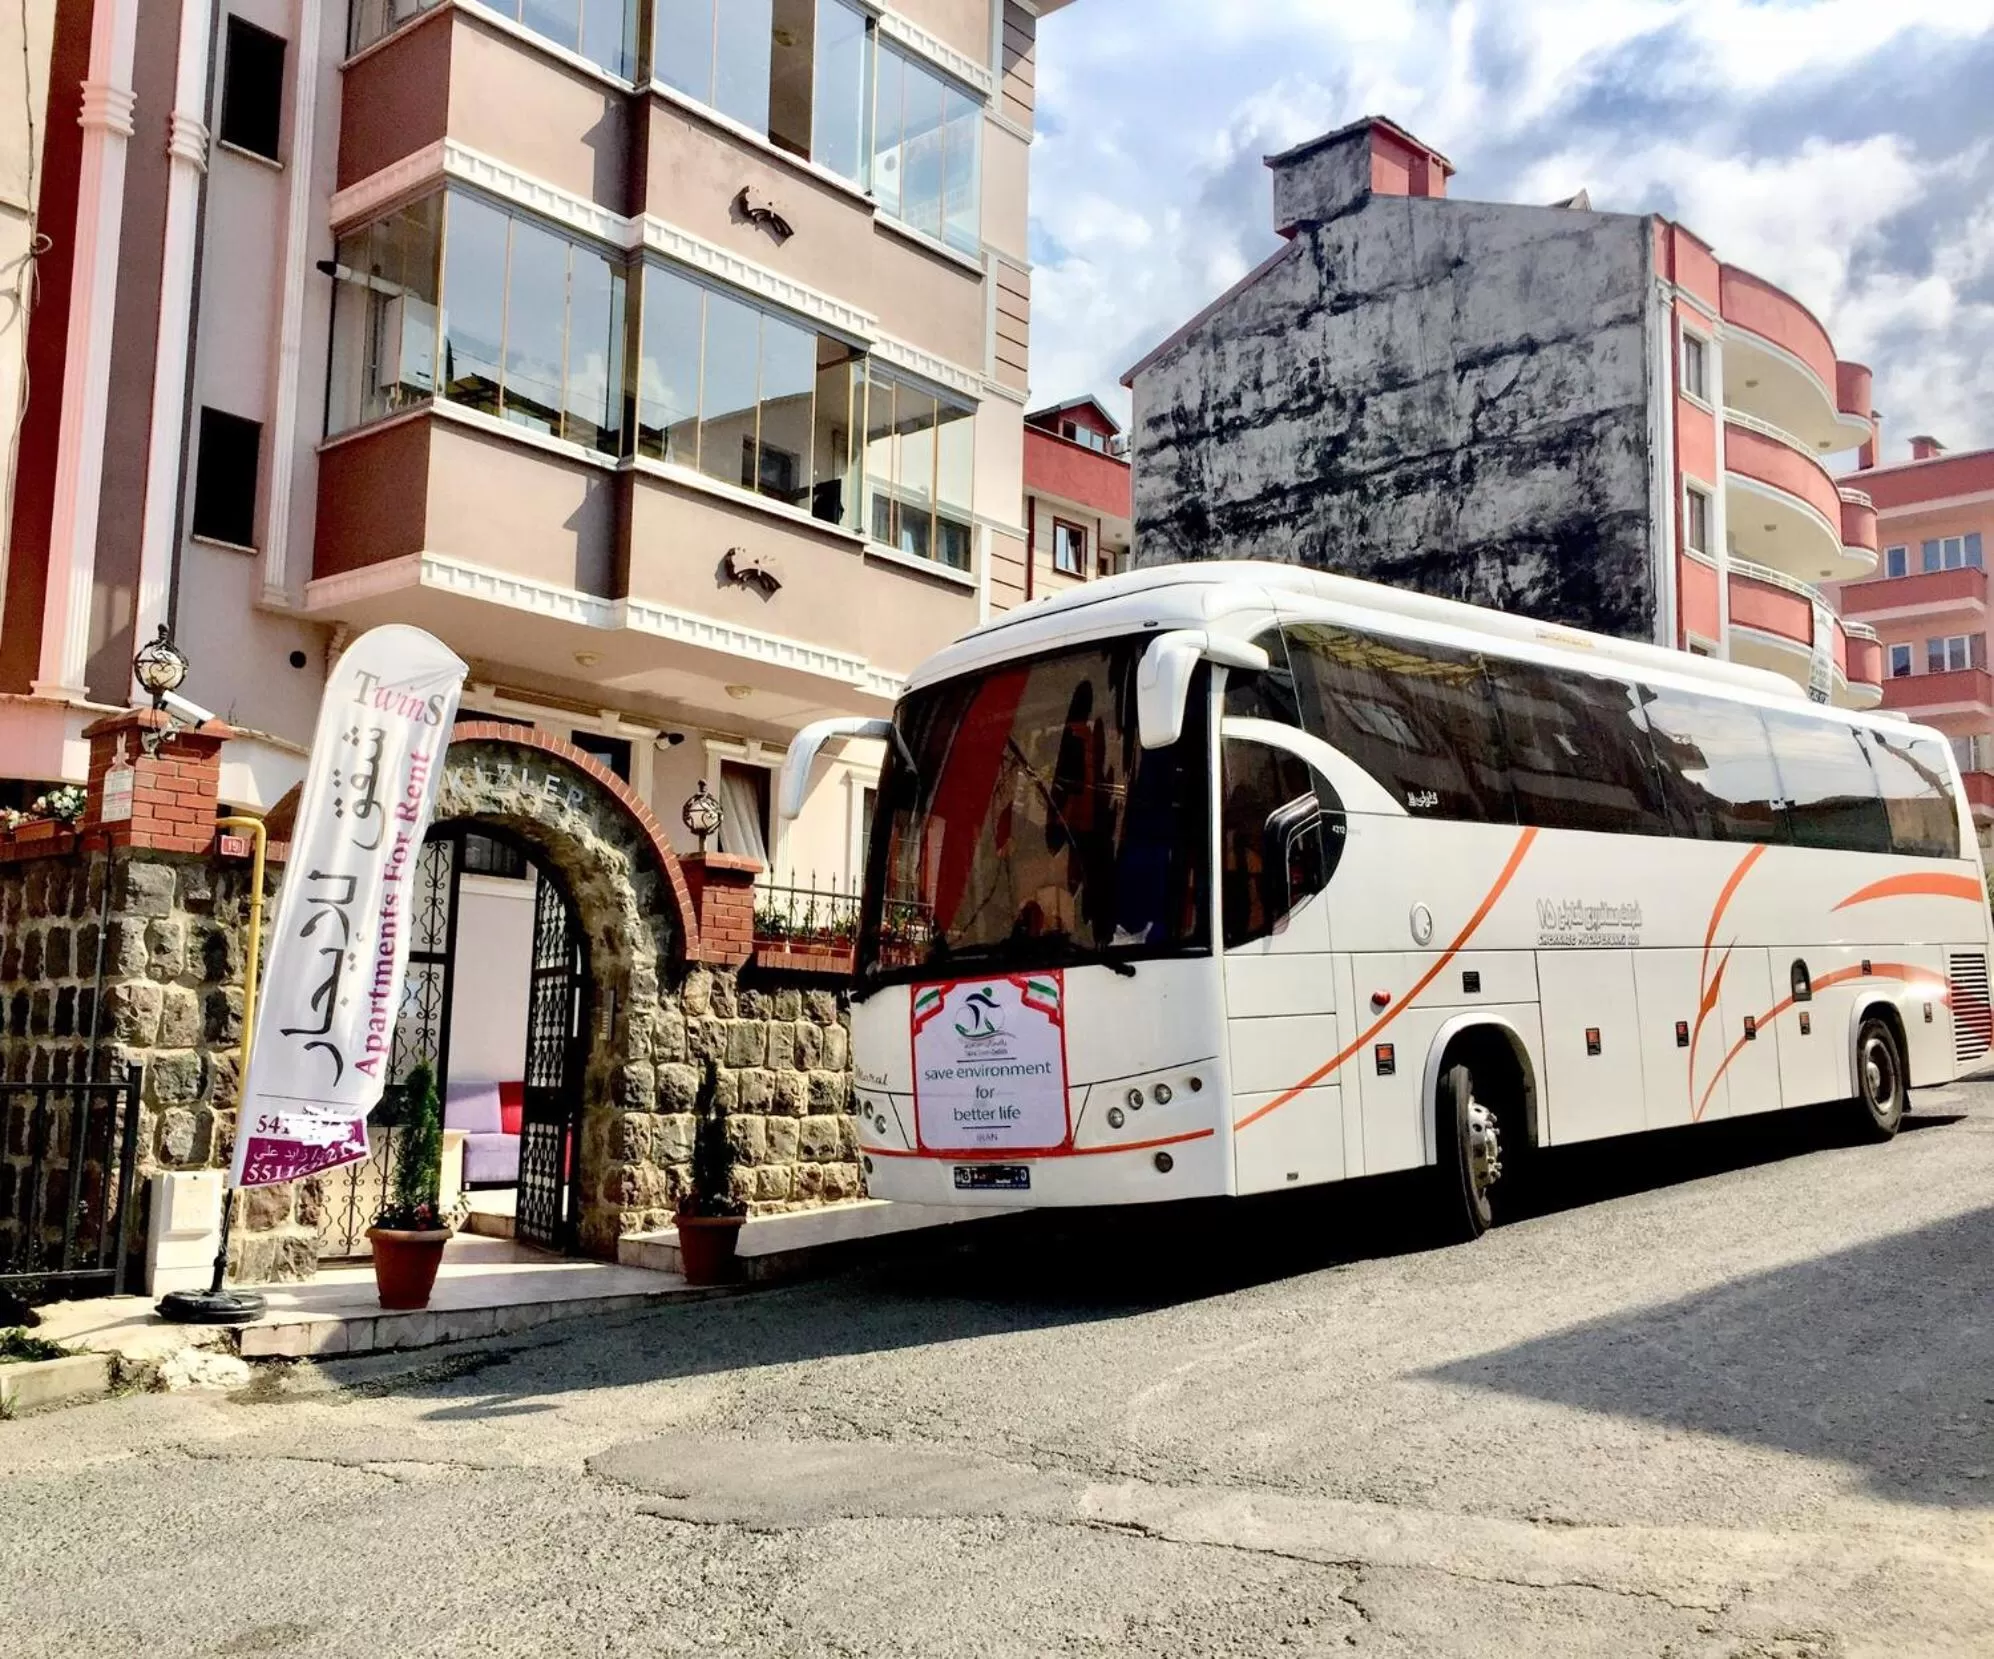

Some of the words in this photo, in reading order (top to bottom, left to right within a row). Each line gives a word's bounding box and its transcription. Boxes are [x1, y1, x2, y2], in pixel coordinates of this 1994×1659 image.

[395, 750, 431, 823] Rent
[382, 831, 412, 883] For
[354, 892, 400, 1079] Apartments
[924, 1067, 954, 1081] save
[956, 1061, 1052, 1079] environment
[975, 1085, 995, 1099] for
[953, 1107, 996, 1121] better
[998, 1104, 1022, 1120] life
